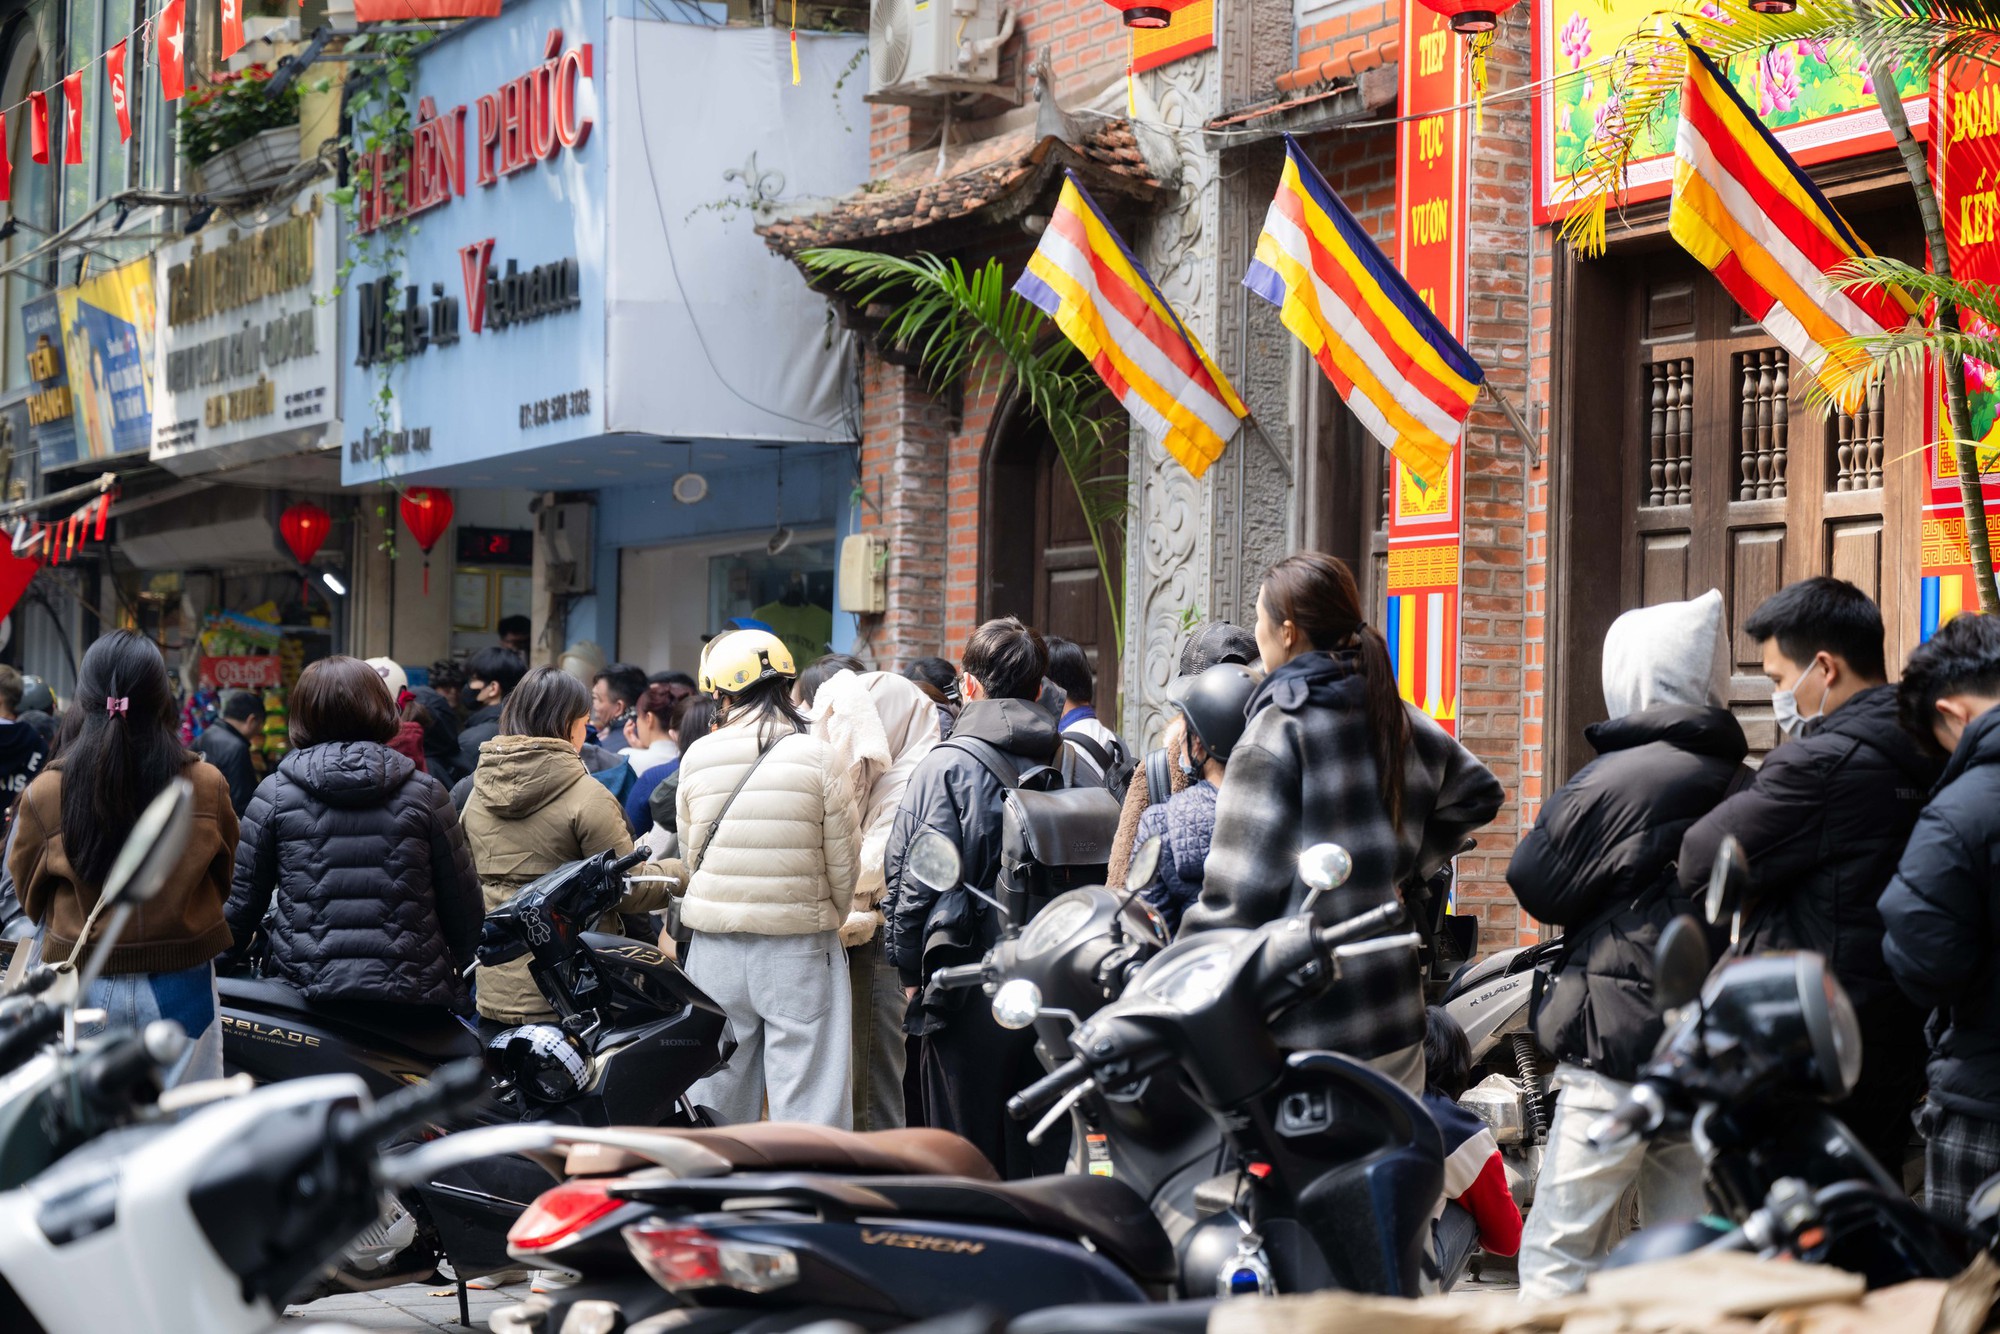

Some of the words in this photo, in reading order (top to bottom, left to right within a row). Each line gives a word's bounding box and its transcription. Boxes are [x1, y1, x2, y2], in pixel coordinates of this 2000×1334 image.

[1419, 12, 1447, 77] TIẾP
[475, 28, 593, 188] PHÚC
[1419, 115, 1444, 170] TỤC
[1411, 196, 1448, 248] VƯƠN
[1959, 166, 1998, 247] KẾT
[430, 282, 460, 348] in
[458, 238, 581, 335] Vietnam
[224, 1028, 248, 1038] BLACK
[251, 1036, 281, 1045] EDITION
[659, 1039, 702, 1047] HONDA
[860, 1227, 987, 1256] VISION
